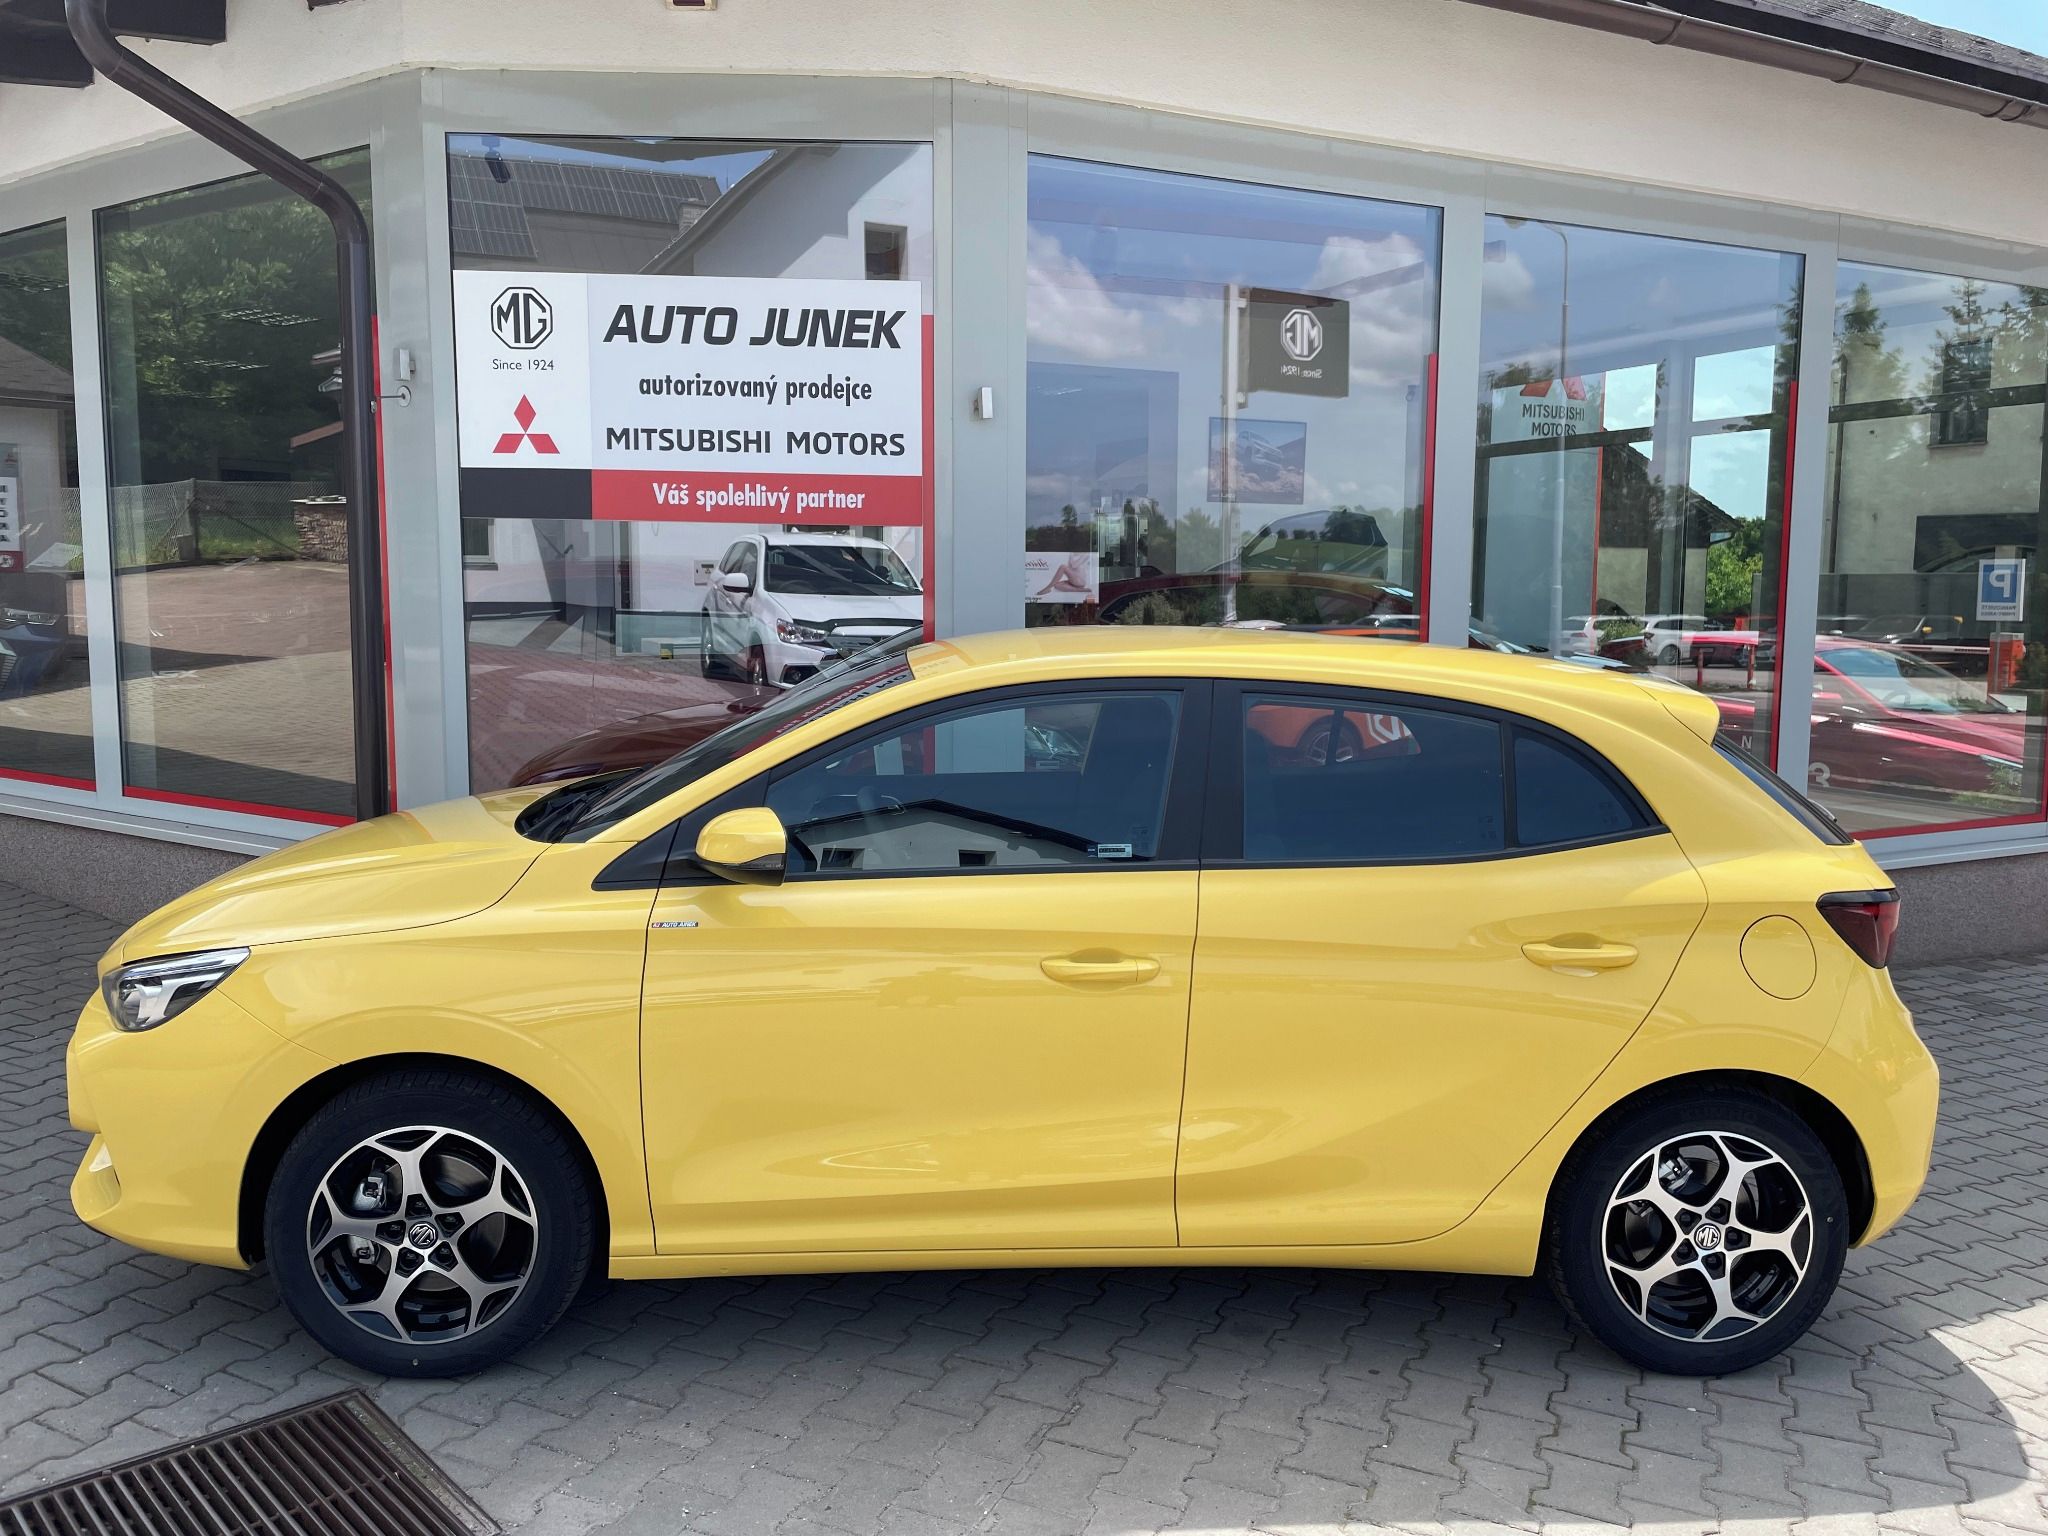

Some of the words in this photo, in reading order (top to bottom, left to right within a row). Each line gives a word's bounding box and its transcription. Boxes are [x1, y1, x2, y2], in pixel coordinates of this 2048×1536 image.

[491, 287, 553, 349] MG
[603, 304, 738, 346] AUTO
[749, 308, 906, 349] JUNEK
[492, 359, 523, 371] Since
[527, 359, 554, 371] 1924
[639, 373, 778, 405] autorizovaný
[786, 374, 872, 407] prodejce
[1522, 403, 1584, 421] MITSUBISHI
[606, 427, 772, 454] MITSUBISHI
[786, 432, 905, 456] MOTORS
[1532, 422, 1576, 436] MOTORS
[653, 483, 690, 505] Váš
[696, 483, 790, 514] spolehlivý
[797, 490, 865, 514] partner
[410, 1224, 436, 1246] MG
[1696, 1225, 1720, 1249] MG
